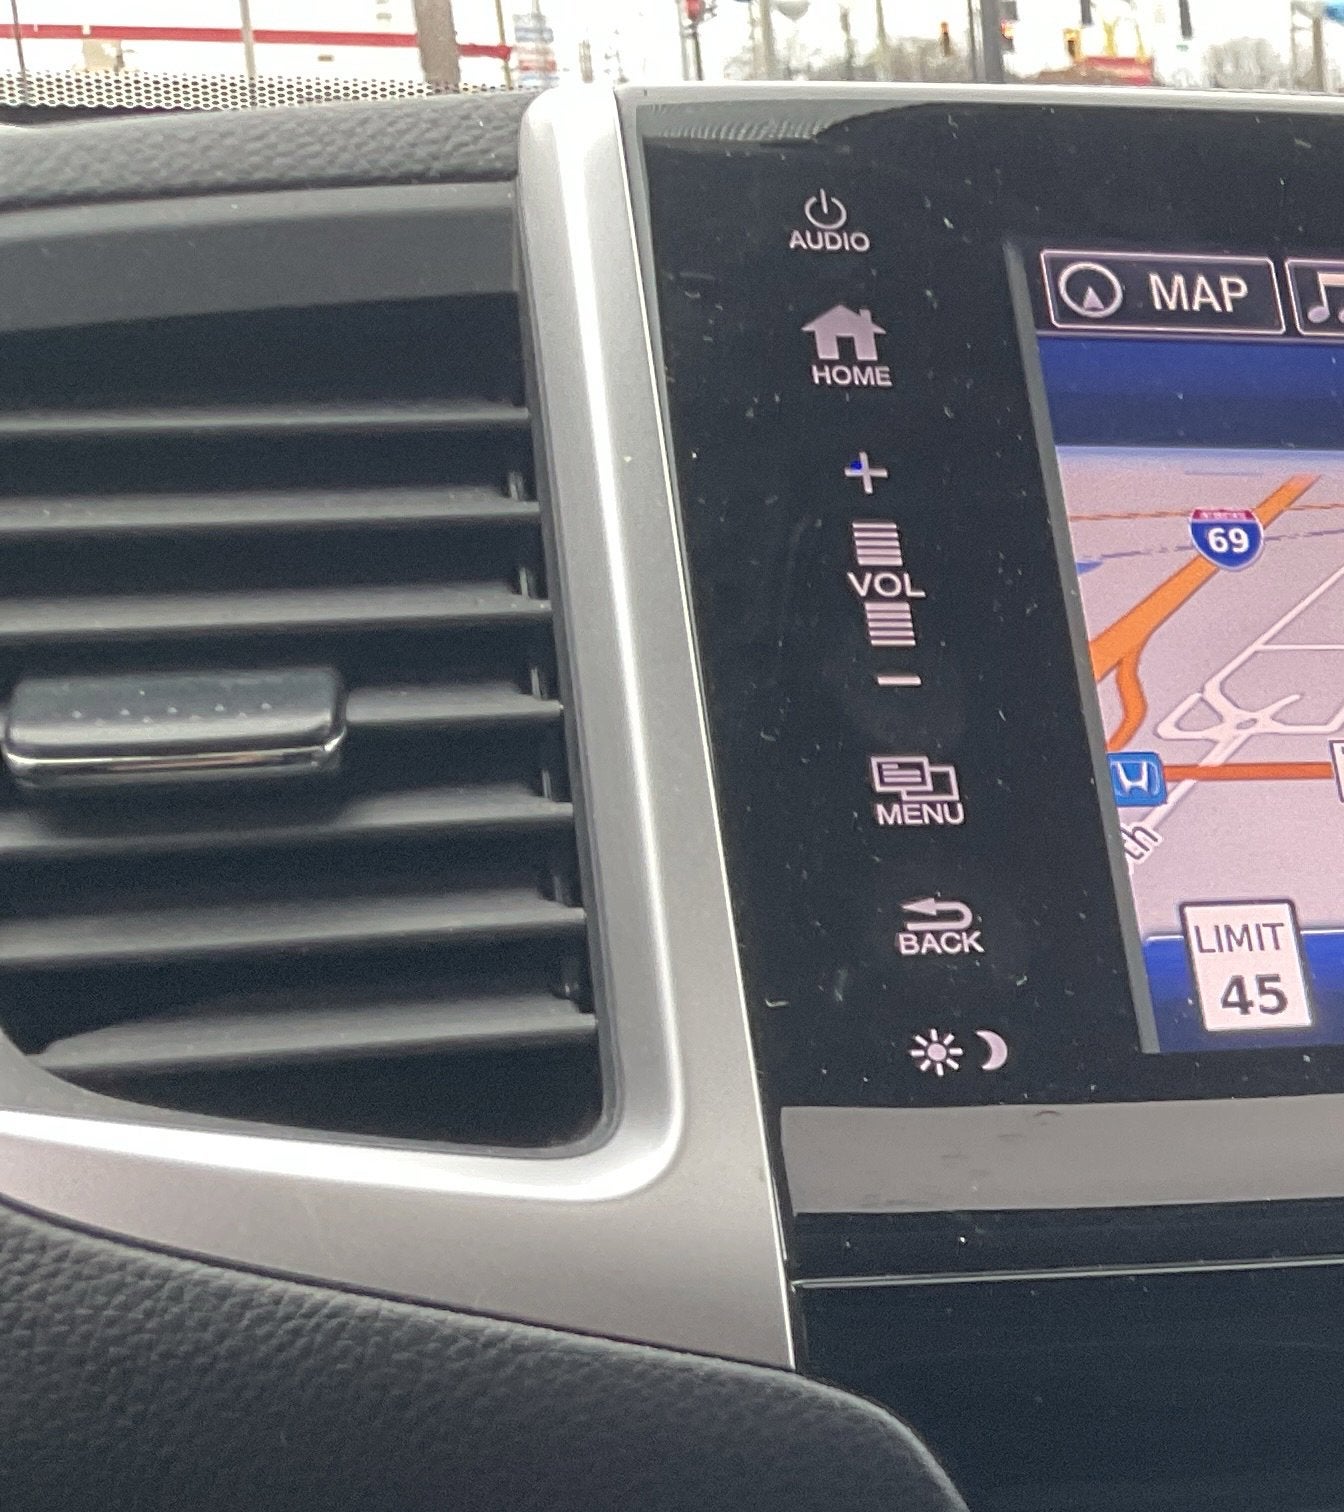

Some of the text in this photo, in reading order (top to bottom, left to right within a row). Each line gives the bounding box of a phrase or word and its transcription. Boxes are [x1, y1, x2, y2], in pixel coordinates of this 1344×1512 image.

[789, 229, 870, 253] AUDIO
[1149, 273, 1249, 313] MAP
[812, 365, 892, 387] HOME
[1207, 527, 1250, 554] 69
[847, 571, 926, 598] VOL
[877, 803, 965, 826] MENU
[899, 931, 985, 955] BACK
[1194, 921, 1285, 955] LIMIT
[1220, 973, 1288, 1017] 45
